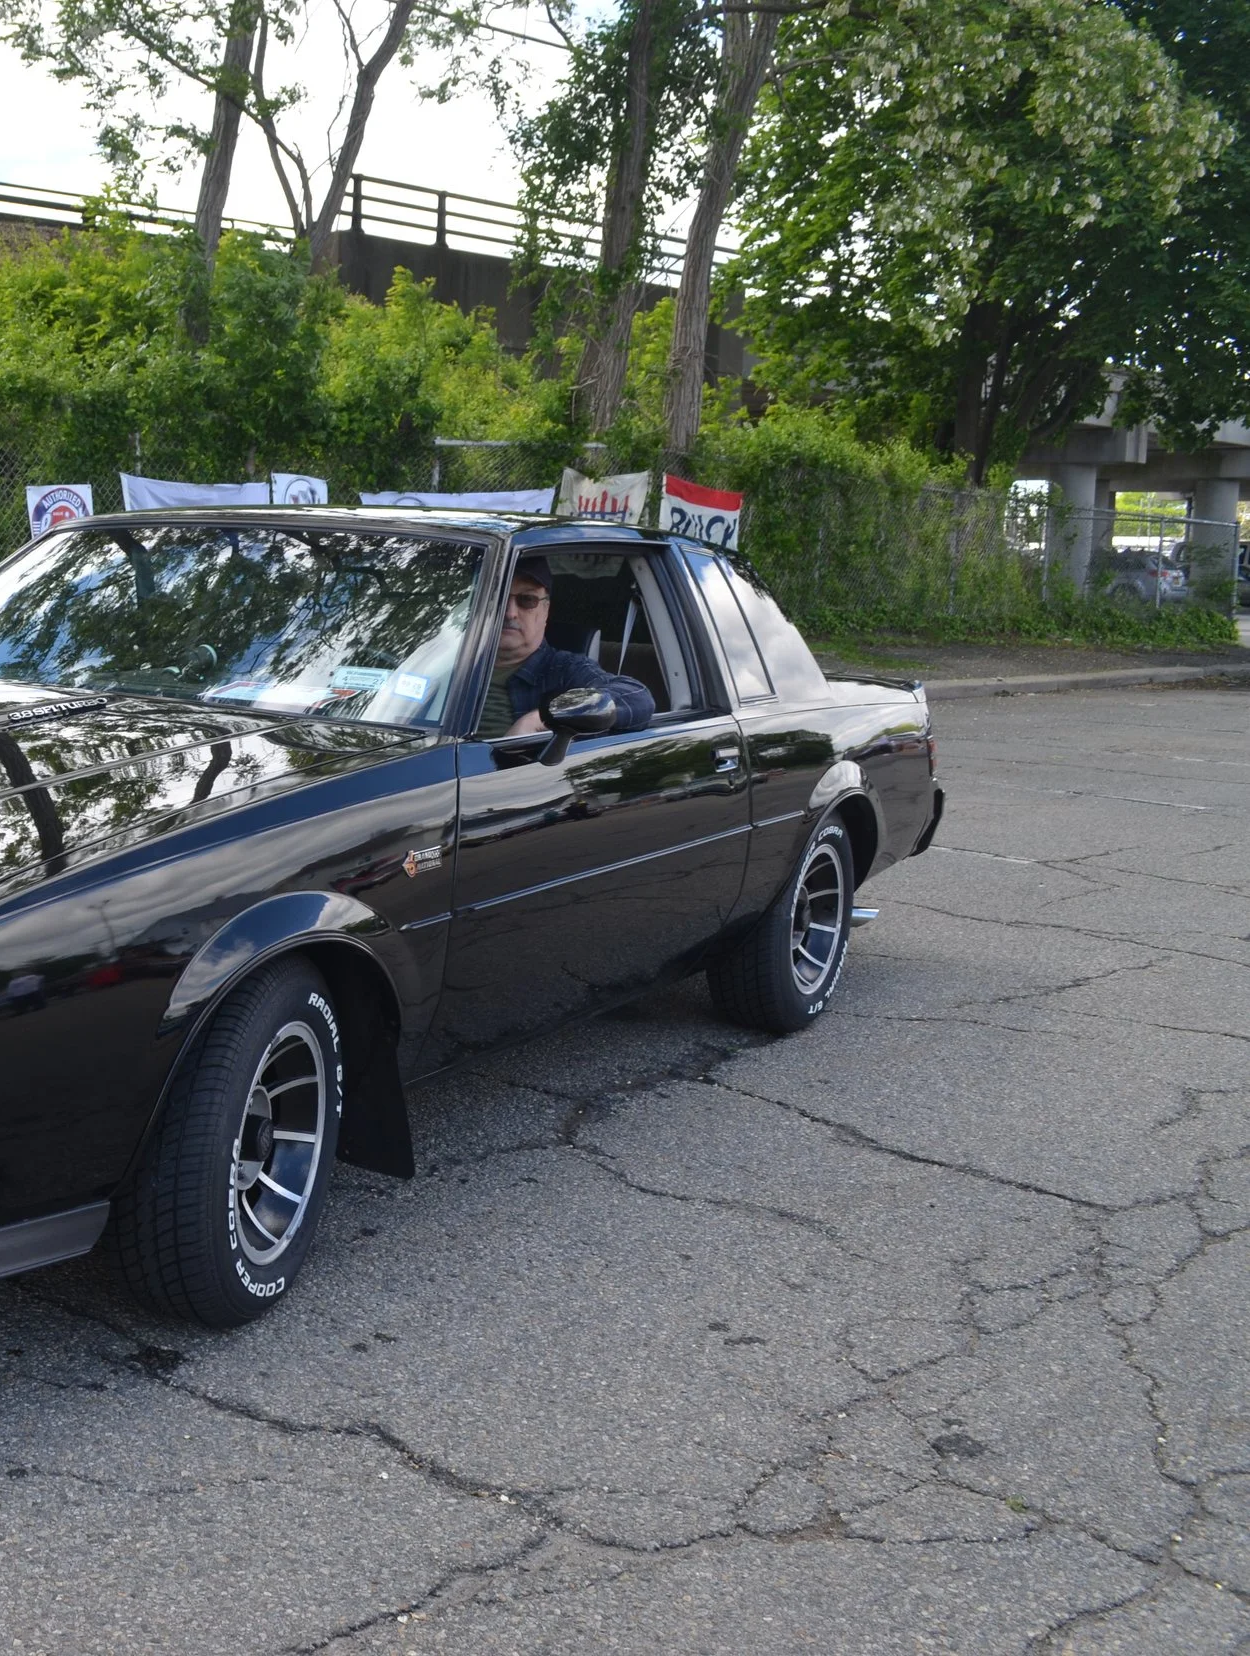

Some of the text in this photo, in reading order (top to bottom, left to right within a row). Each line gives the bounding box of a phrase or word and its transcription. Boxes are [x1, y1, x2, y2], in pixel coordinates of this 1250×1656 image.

[42, 490, 82, 509] AUTHORIZED
[55, 697, 108, 711] TURBO
[818, 825, 844, 842] COBRA
[307, 992, 340, 1053] RADIAL
[235, 1258, 286, 1297] COOPER
